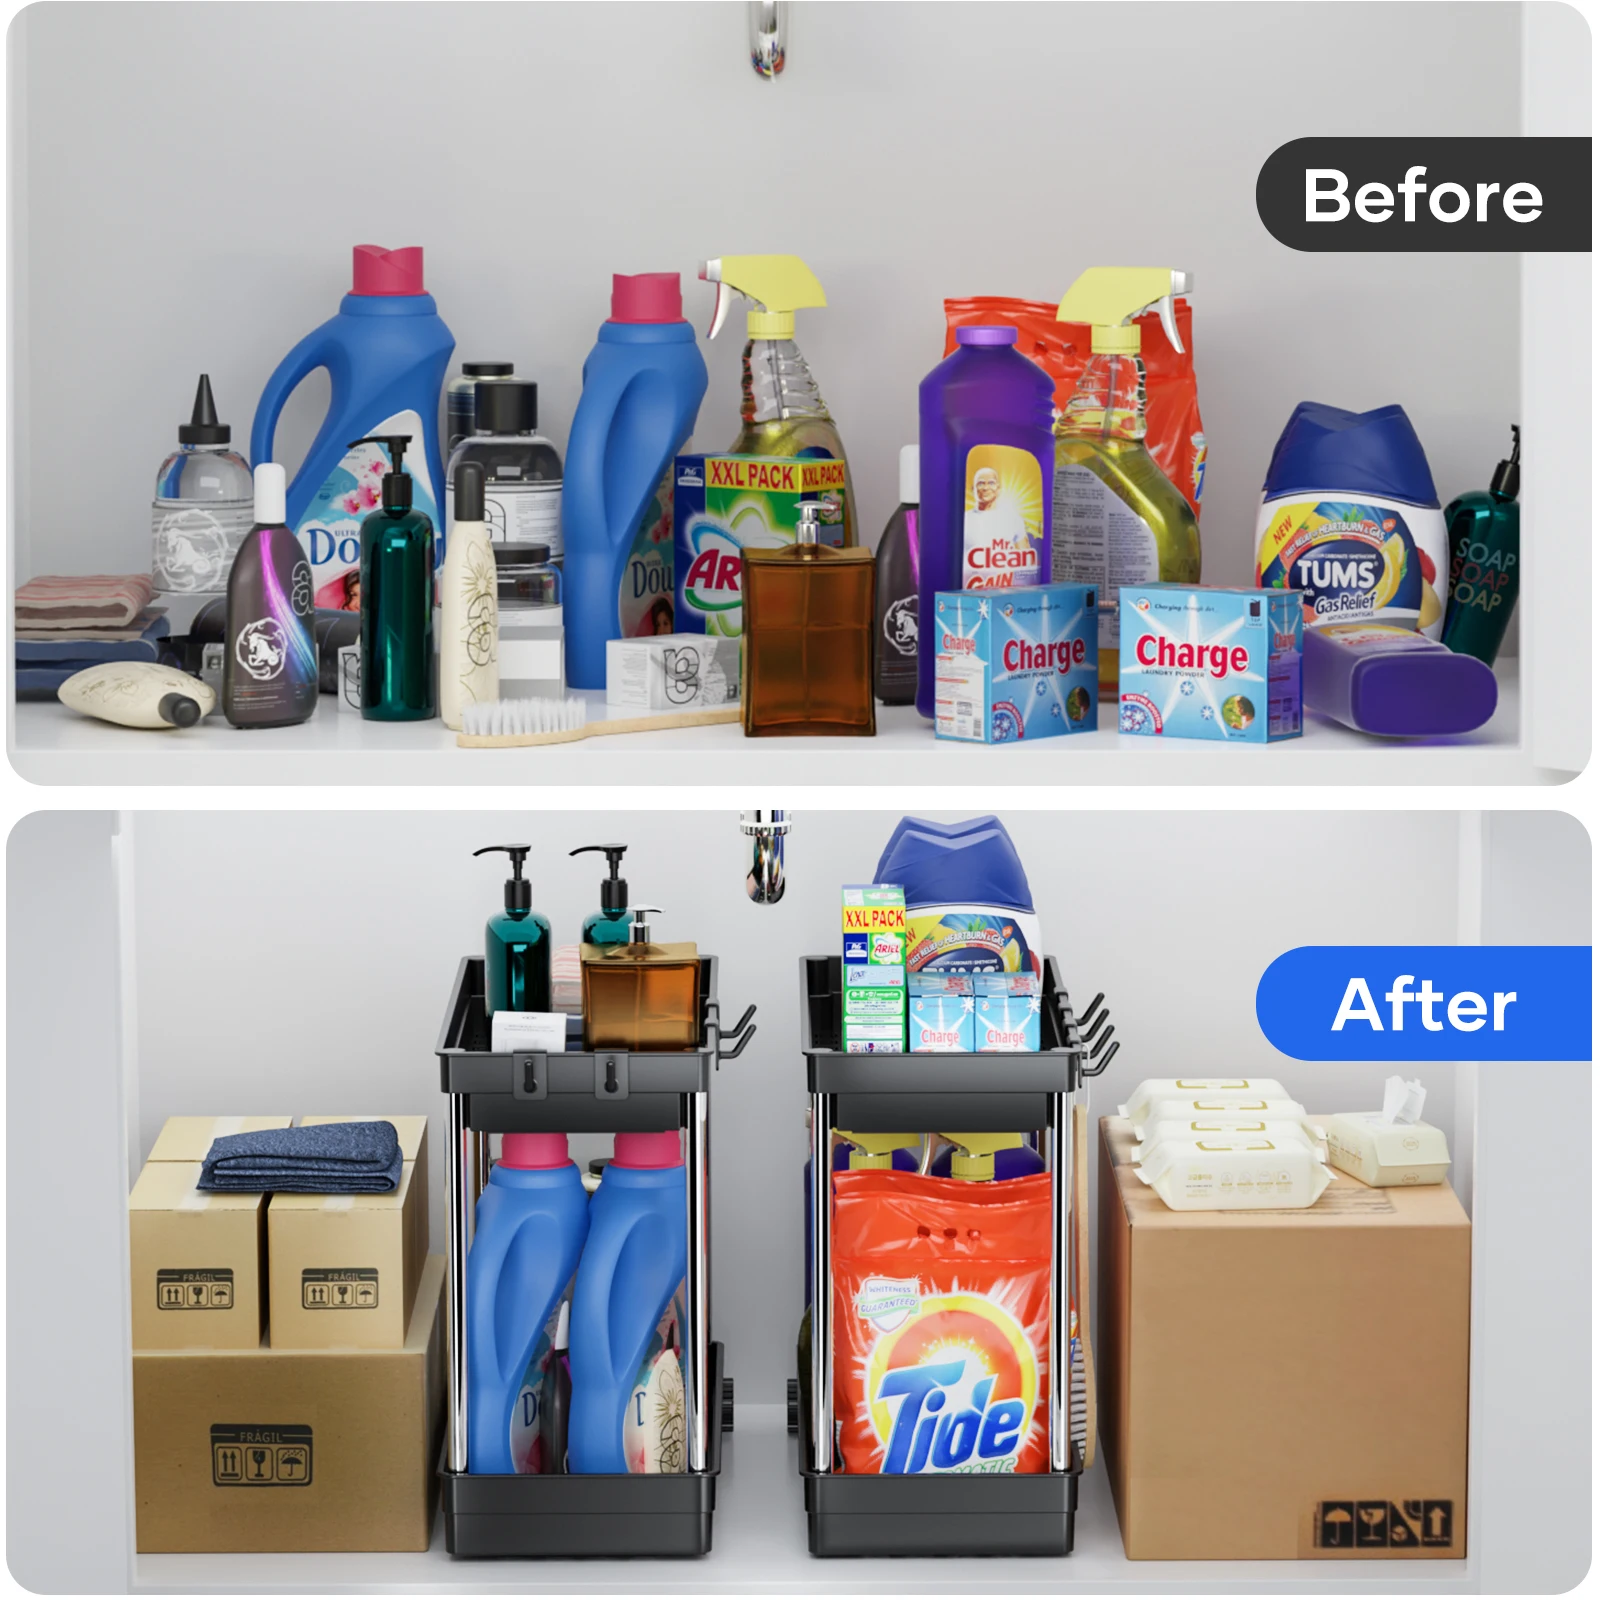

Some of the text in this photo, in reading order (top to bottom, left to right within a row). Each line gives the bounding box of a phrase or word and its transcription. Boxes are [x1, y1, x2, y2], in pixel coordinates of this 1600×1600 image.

[711, 461, 795, 490] XXL PACK
[802, 464, 845, 487] XXL PACK
[1273, 515, 1293, 545] NEW
[1318, 521, 1364, 535] HEARTBURN
[1369, 526, 1385, 541] GAS
[992, 538, 1014, 550] Mr.
[967, 547, 1037, 569] Clean
[1456, 537, 1517, 573] SOAP
[966, 572, 1014, 590] GAIN
[1296, 559, 1375, 589] TUMS
[1450, 557, 1509, 592] SOAP
[1315, 591, 1377, 615] Gas Relief
[1448, 578, 1502, 613] SOAP
[1154, 603, 1182, 612] Charging
[943, 633, 976, 655] Charge
[1003, 637, 1085, 675] Charge
[1136, 634, 1249, 680] Charge
[1008, 673, 1031, 681] LAUNDRY
[1141, 668, 1205, 678] LAUNDRY POWDER
[845, 909, 905, 927] XXL PACK
[874, 943, 899, 953] ARIEL
[909, 953, 921, 966] FAST
[920, 942, 938, 958] RELIEF
[944, 930, 987, 945] HEARTBURN
[991, 934, 1005, 947] GAS
[921, 1029, 959, 1047] Charge
[986, 1029, 1025, 1047] Charge
[183, 1271, 216, 1283] FRÁGIL
[328, 1271, 360, 1282] FRÁGIL
[860, 1297, 916, 1313] GUARANTEED
[877, 1359, 1025, 1474] Tide
[240, 1428, 284, 1444] FRÁGIL
